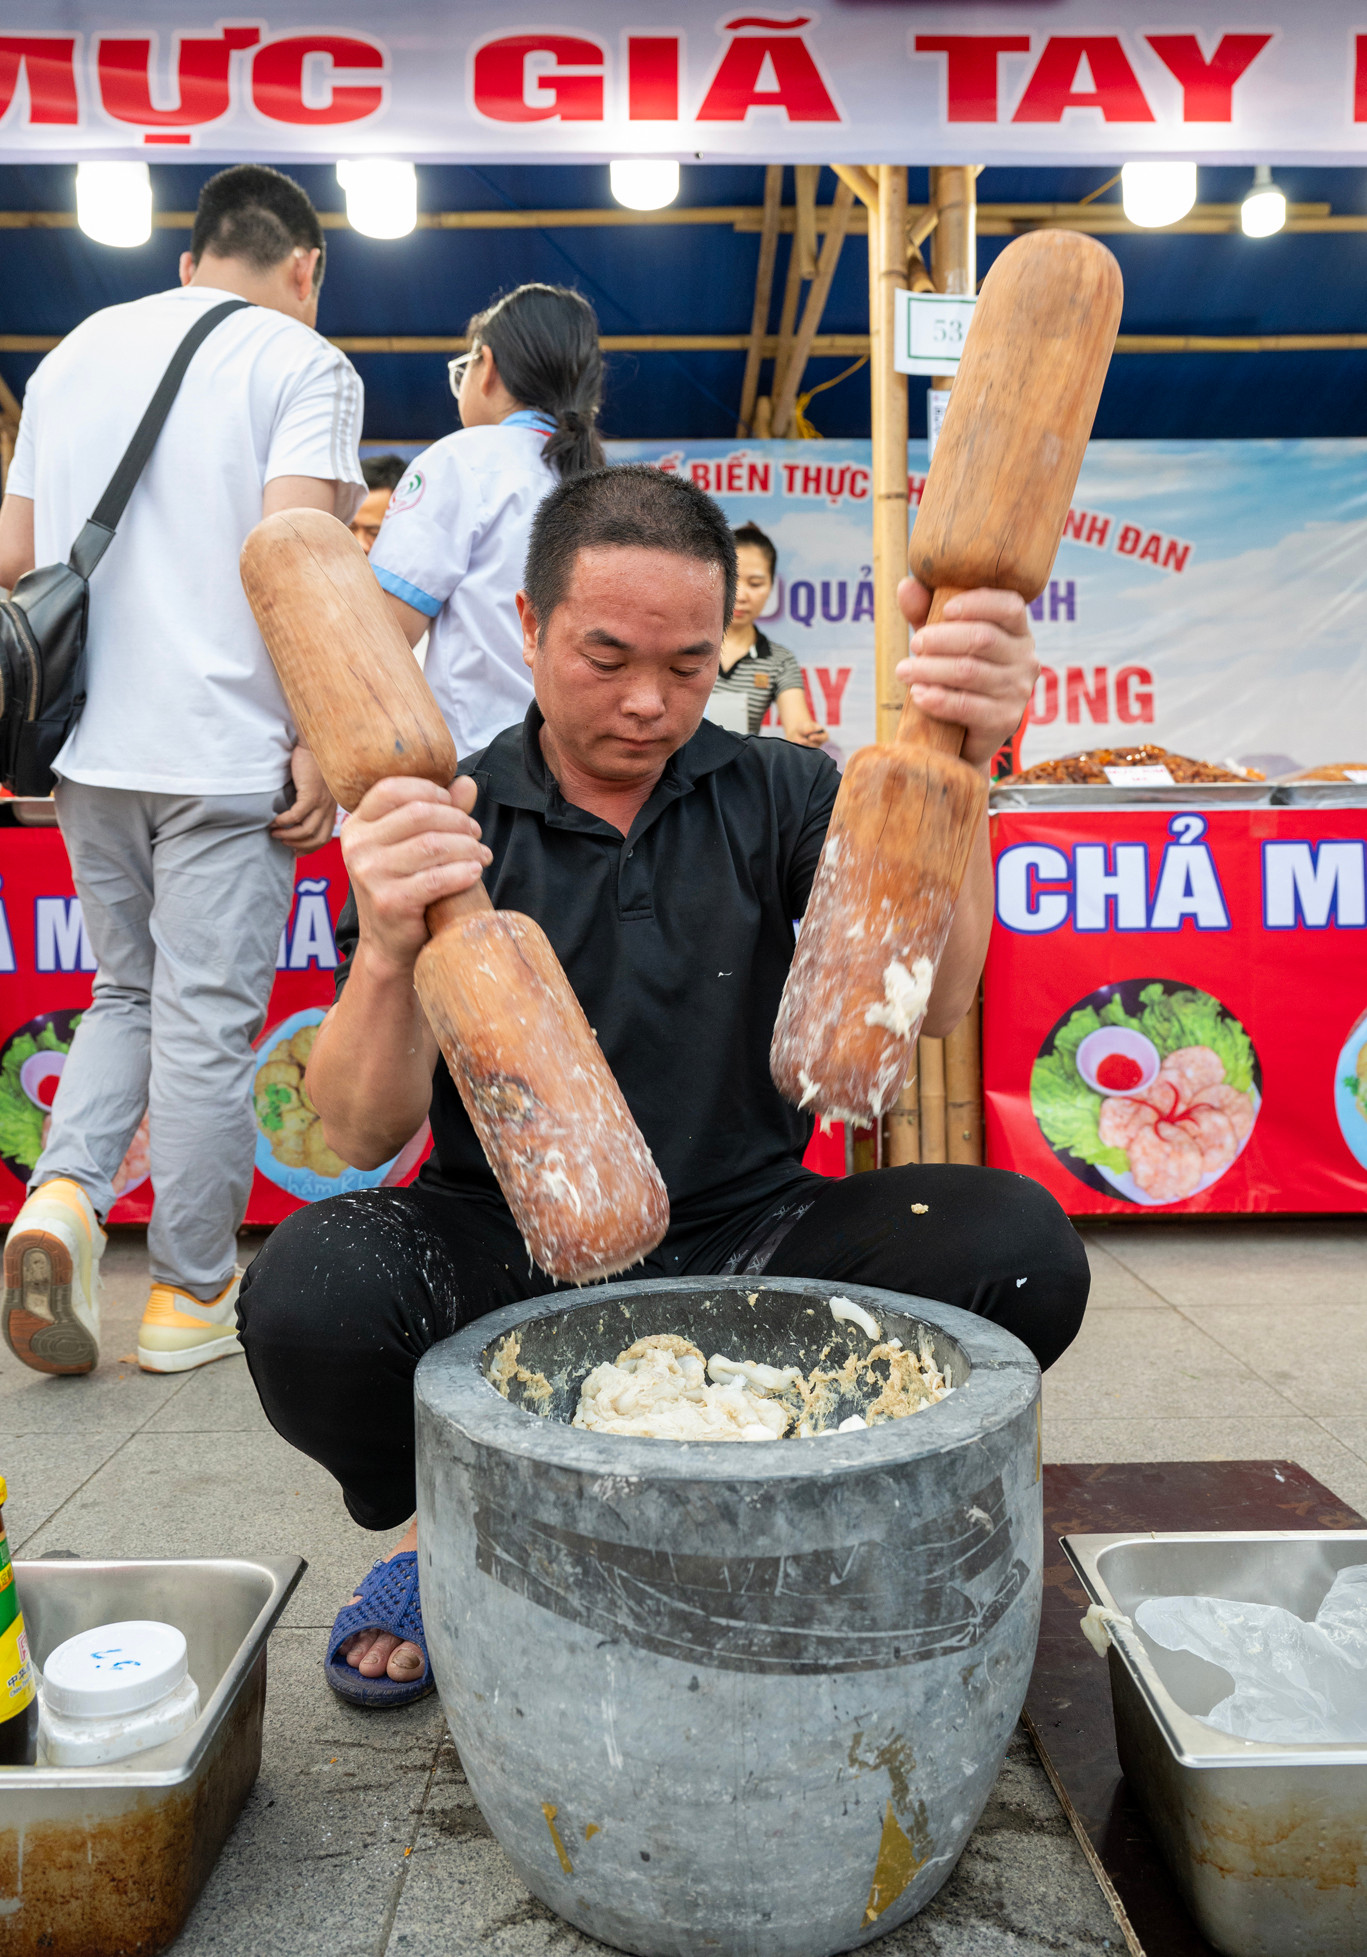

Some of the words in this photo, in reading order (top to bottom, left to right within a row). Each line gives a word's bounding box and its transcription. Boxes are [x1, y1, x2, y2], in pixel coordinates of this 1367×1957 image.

[473, 17, 842, 123] GIÃ
[915, 34, 1274, 123] TAY
[933, 319, 963, 342] 53
[690, 451, 770, 492] BIẾN
[782, 463, 869, 504] THỰC
[995, 812, 1232, 935] CHẢ
